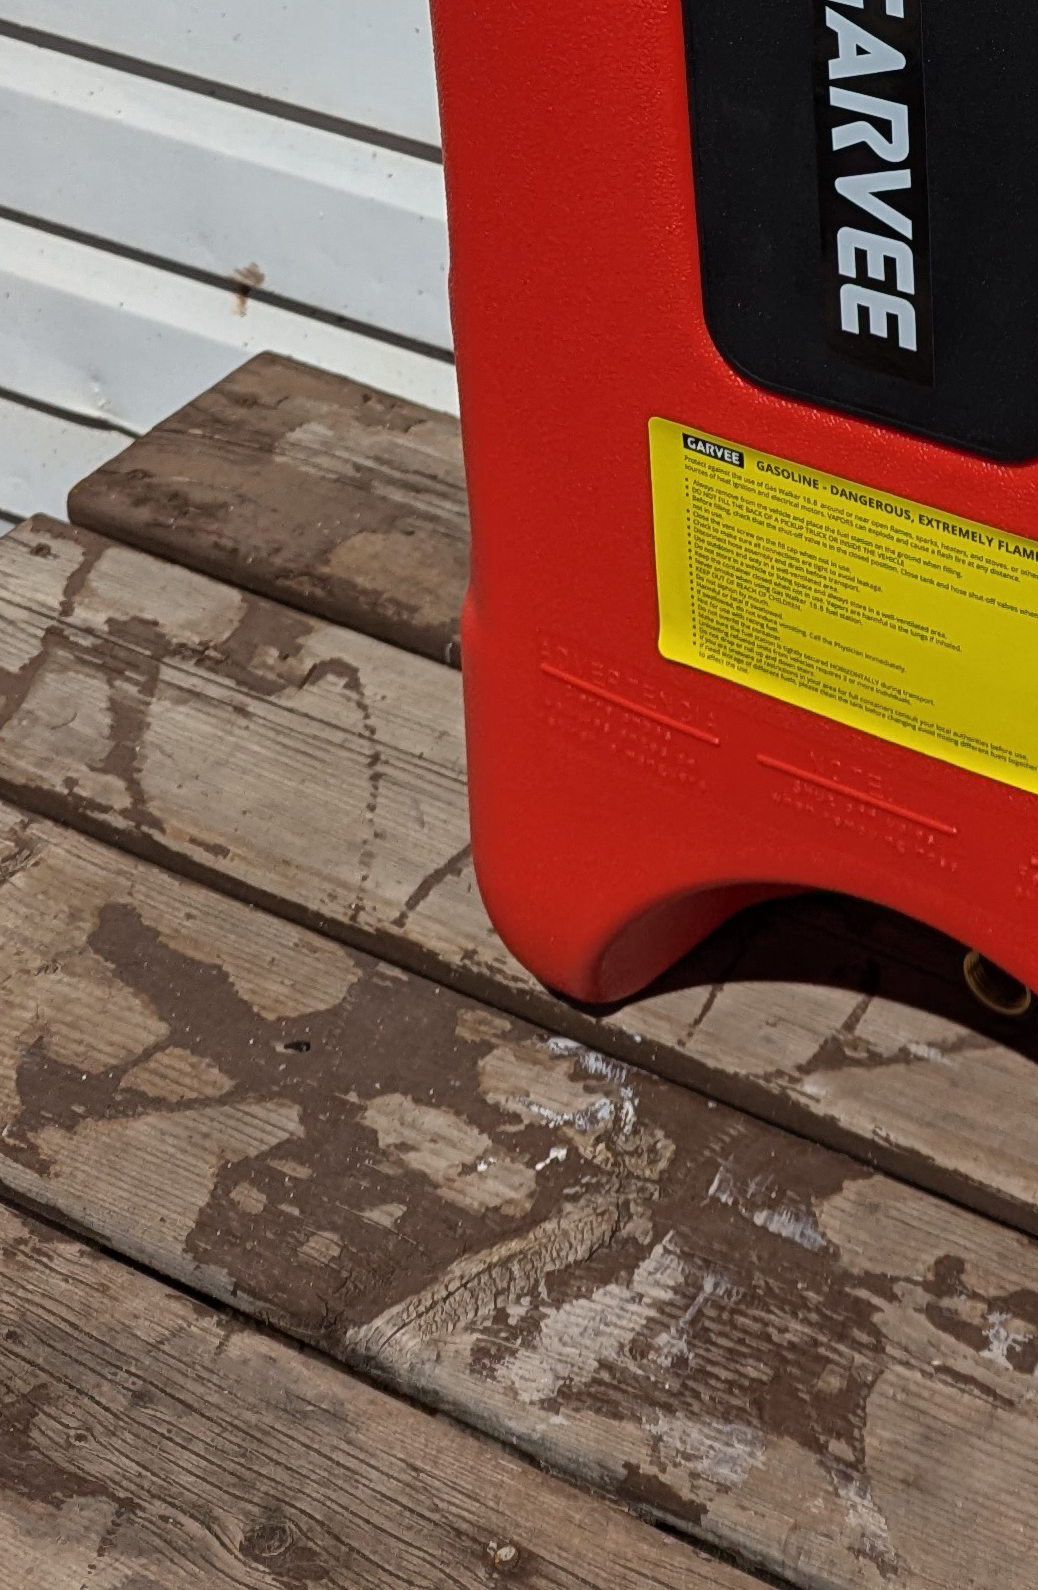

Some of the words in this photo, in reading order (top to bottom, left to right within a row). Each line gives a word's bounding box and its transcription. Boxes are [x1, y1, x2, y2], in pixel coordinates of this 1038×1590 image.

[686, 435, 740, 465] GARVEE
[756, 459, 819, 490] GASOLINE
[830, 483, 914, 524] DANGEROUS,
[918, 513, 994, 548] EXTREMELY
